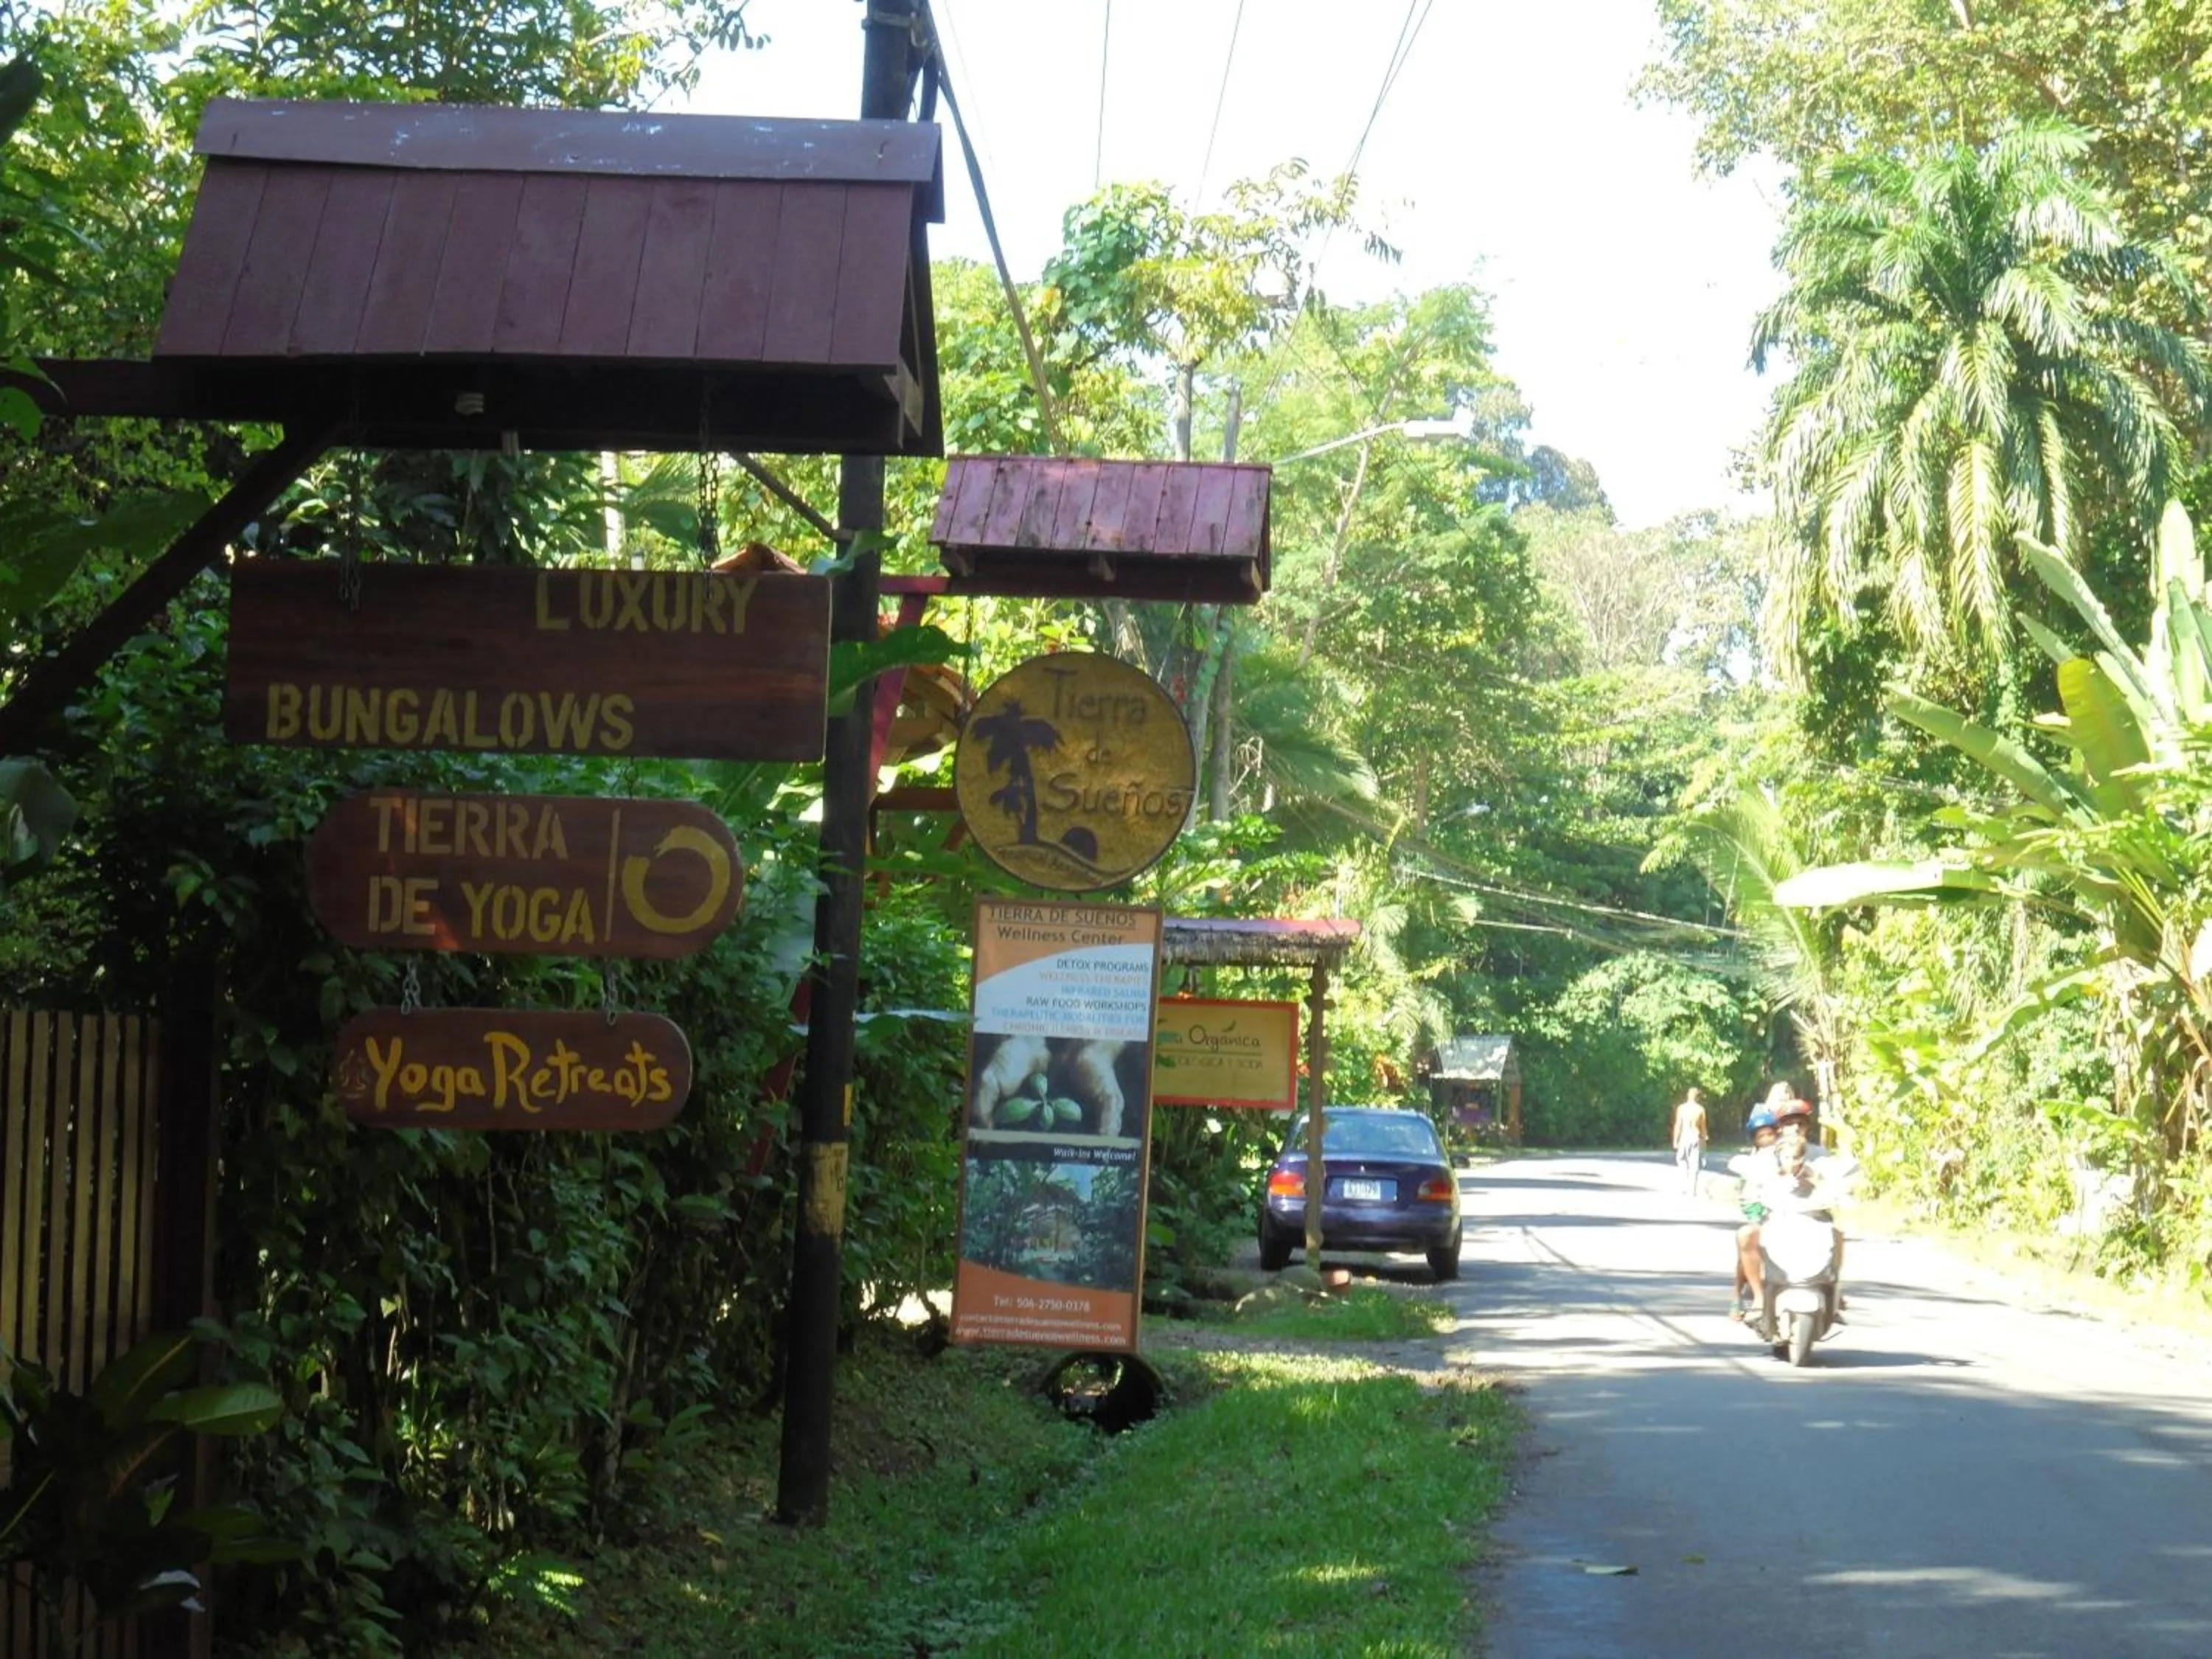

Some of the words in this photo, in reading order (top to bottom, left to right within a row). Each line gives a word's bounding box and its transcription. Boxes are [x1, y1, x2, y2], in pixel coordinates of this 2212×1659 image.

[536, 573, 759, 634] LUXURY
[266, 684, 635, 750] BUNGALOWS
[1043, 667, 1147, 726] Tierra
[1085, 730, 1112, 765] de
[1041, 772, 1183, 817] Sueños
[369, 798, 568, 860] TIERRA
[369, 877, 438, 934] DE
[461, 880, 595, 944] YOGA
[990, 907, 1043, 922] TIERRA
[1050, 909, 1068, 922] DE
[997, 925, 1065, 942] Wellness
[1071, 929, 1124, 945] Center
[1057, 959, 1090, 970] DETOX
[1093, 960, 1149, 973] PROGRAMS
[1026, 996, 1049, 1007] RAW
[1052, 998, 1080, 1009] FOOD
[1084, 999, 1147, 1012] WORKSHOPS
[366, 1036, 485, 1112] Yoga
[484, 1031, 672, 1113] Retreats
